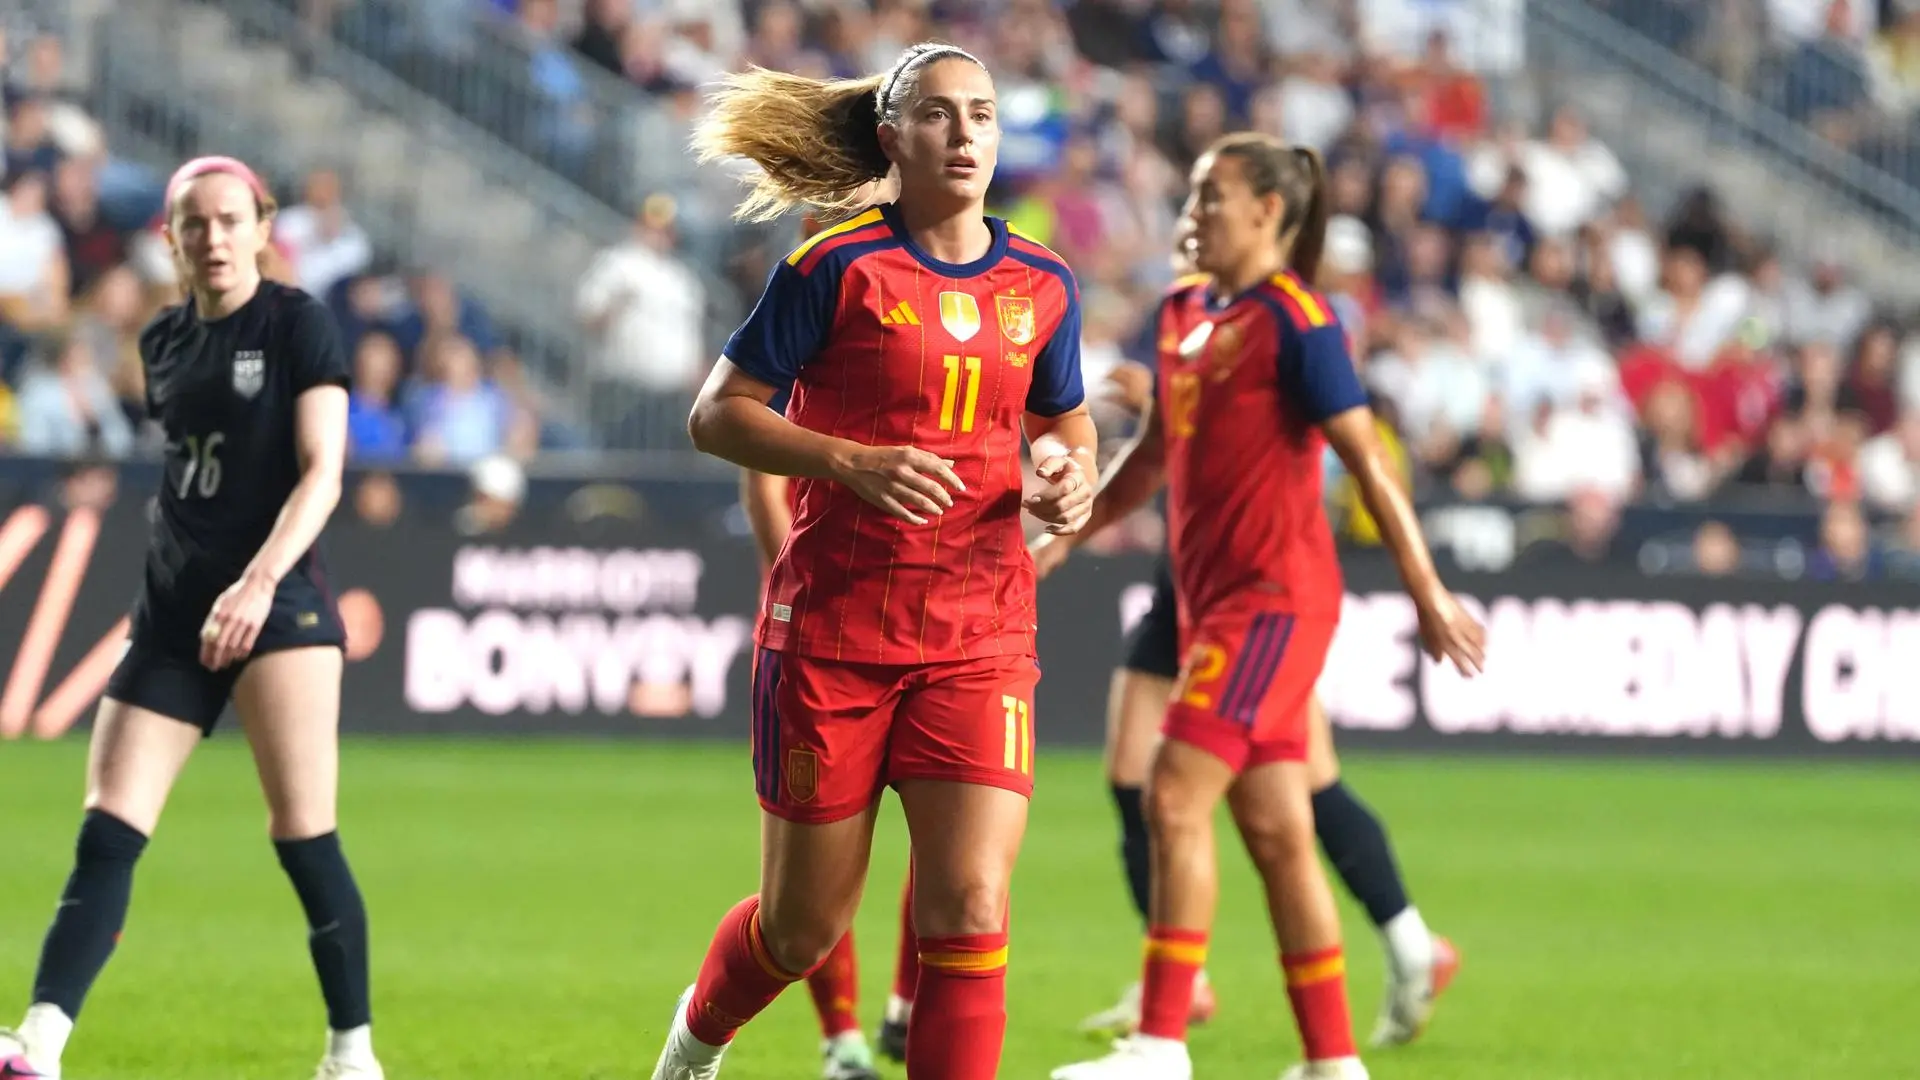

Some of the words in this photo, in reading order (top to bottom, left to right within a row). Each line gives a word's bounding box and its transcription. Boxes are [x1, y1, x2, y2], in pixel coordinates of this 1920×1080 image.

[939, 355, 982, 433] 11
[405, 609, 749, 718] BONVOY
[1002, 694, 1029, 776] 11
